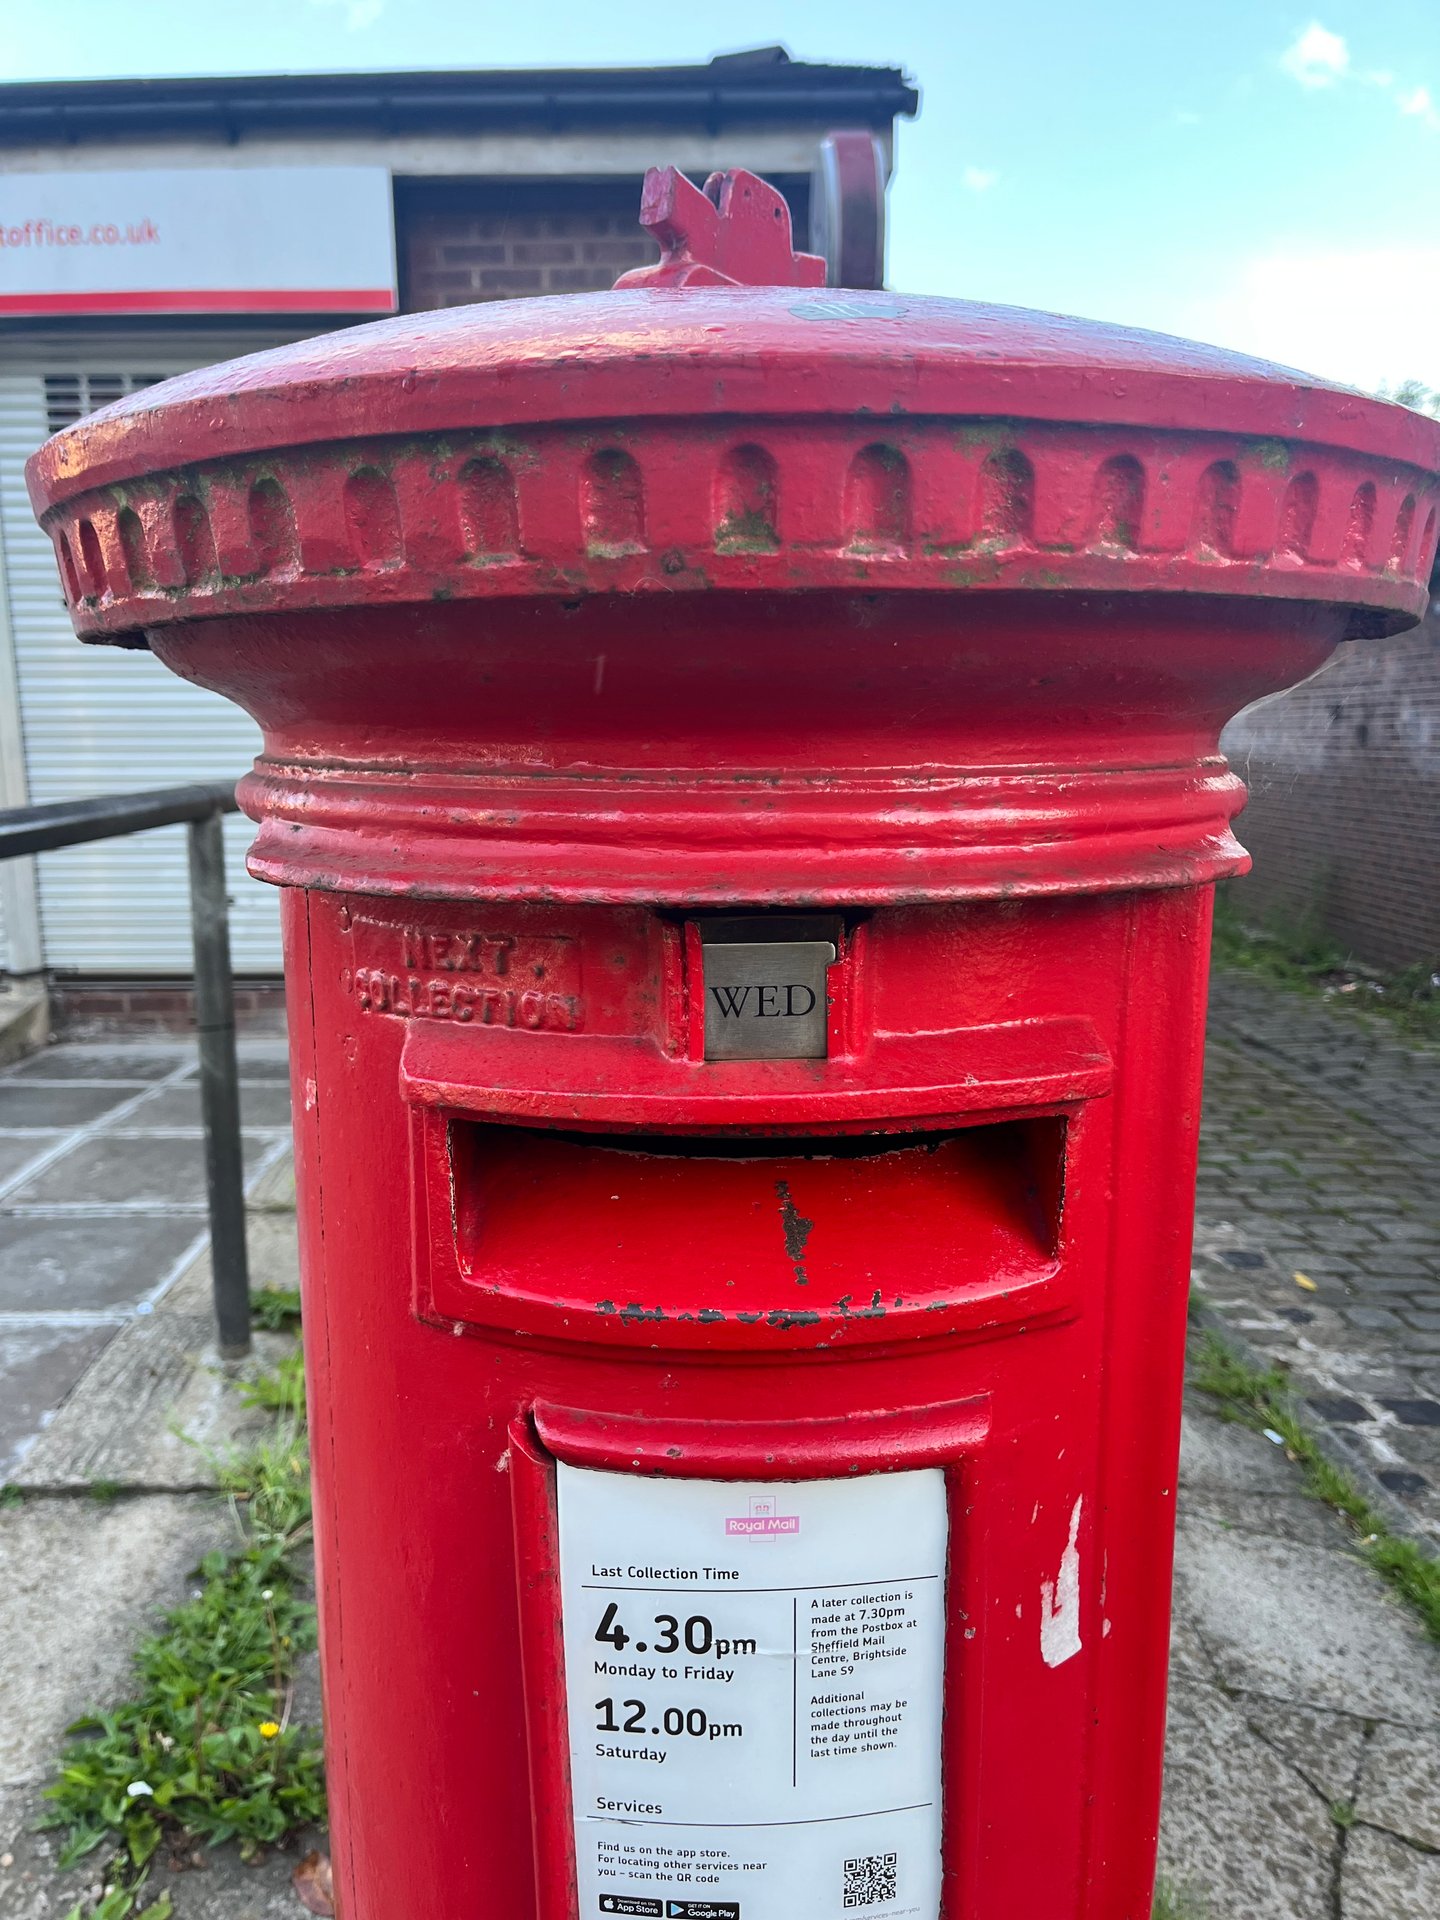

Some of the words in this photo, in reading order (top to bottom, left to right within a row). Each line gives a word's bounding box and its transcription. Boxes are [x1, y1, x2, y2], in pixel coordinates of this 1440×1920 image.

[403, 929, 517, 974] NEXT
[709, 984, 816, 1017] WED
[729, 1519, 765, 1532] Royal
[768, 1518, 795, 1530] Mail
[592, 1565, 622, 1577] Last
[627, 1566, 698, 1579] Collection
[703, 1568, 740, 1579] Time
[811, 1600, 819, 1608] A
[822, 1599, 847, 1608] later
[851, 1593, 901, 1605] collection
[905, 1591, 914, 1600] is
[811, 1614, 841, 1624] made
[844, 1613, 856, 1621] at
[859, 1606, 905, 1622] 7.30pm
[595, 1602, 757, 1659] 4.30pm
[811, 1628, 837, 1638] from
[841, 1625, 858, 1635] the
[862, 1622, 903, 1633] Postbox
[906, 1619, 917, 1628] at
[811, 1638, 859, 1653] Sheffield
[863, 1636, 885, 1646] Mail
[811, 1654, 849, 1665] Centre,
[853, 1647, 907, 1661] Brightside
[594, 1661, 656, 1680] Monday
[662, 1666, 678, 1679] to
[684, 1667, 735, 1682] Friday
[811, 1669, 837, 1678] Lane
[841, 1666, 854, 1676] S9
[811, 1692, 865, 1705] Additional
[811, 1705, 866, 1718] collections
[870, 1703, 892, 1714] may
[895, 1699, 908, 1708] be
[595, 1698, 743, 1740] 12.00pm
[811, 1721, 840, 1731] made
[844, 1713, 902, 1729] throughout
[811, 1735, 828, 1744] the
[831, 1732, 850, 1743] day
[854, 1731, 878, 1740] until
[881, 1727, 898, 1736] the
[595, 1743, 667, 1763] Saturday
[811, 1748, 830, 1758] last
[834, 1745, 858, 1754] time
[861, 1741, 897, 1752] shown.
[596, 1797, 662, 1814] Services
[597, 1841, 620, 1852] Find
[623, 1845, 636, 1853] us
[639, 1846, 652, 1854] on
[655, 1847, 673, 1856] the
[676, 1849, 696, 1858] app
[700, 1849, 731, 1858] store.
[598, 1854, 615, 1864] For
[618, 1856, 660, 1870] locating
[663, 1860, 692, 1870] other
[695, 1860, 739, 1871] services
[743, 1861, 768, 1870] near
[597, 1868, 616, 1877] you
[628, 1871, 652, 1880] scan
[655, 1872, 673, 1881] the
[676, 1873, 692, 1883] QR
[695, 1873, 720, 1883] code
[617, 1903, 634, 1913] App
[636, 1906, 659, 1914] Store
[687, 1909, 717, 1918] Google
[718, 1909, 735, 1918] Play
